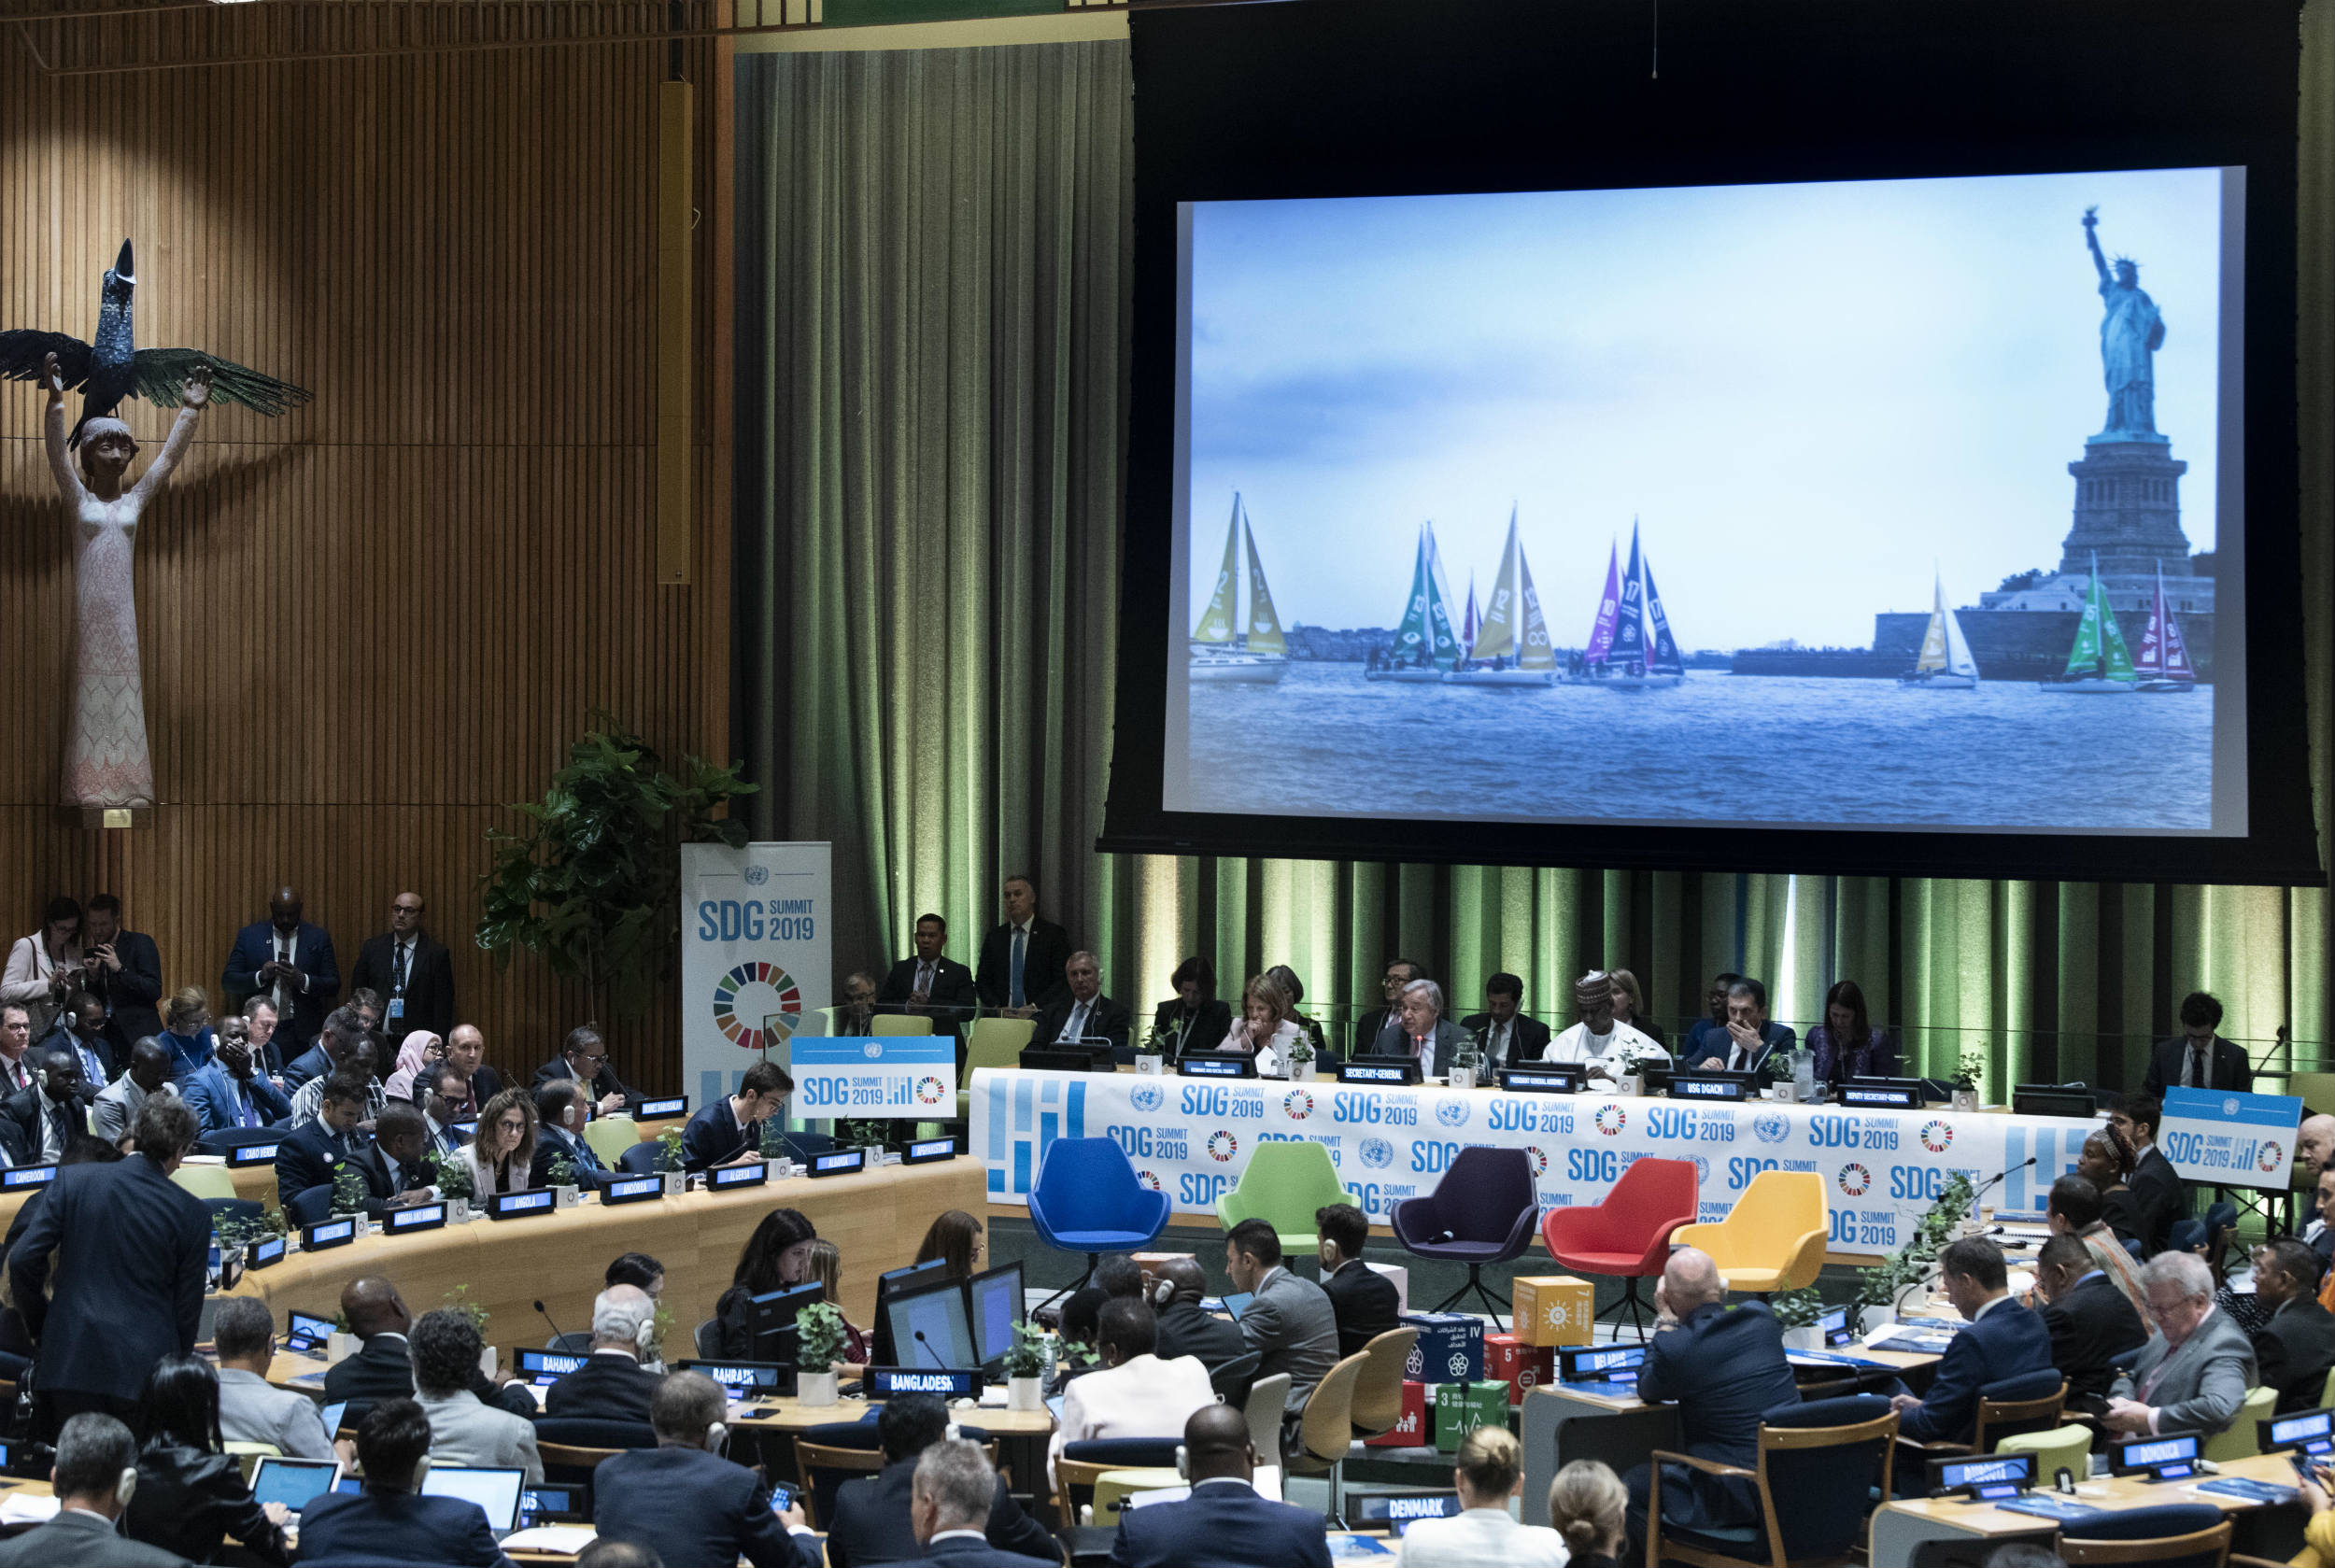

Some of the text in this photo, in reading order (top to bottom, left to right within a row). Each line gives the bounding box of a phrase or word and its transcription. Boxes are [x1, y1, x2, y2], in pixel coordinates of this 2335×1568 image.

[1626, 580, 1640, 602] 17
[770, 899, 814, 914] SUMMIT
[699, 899, 764, 941] SDG
[770, 917, 814, 940] 2019
[853, 1077, 883, 1087] SUMMIT
[1345, 1067, 1403, 1081] SECRETARY-GENERAL
[803, 1076, 849, 1106] SDG
[853, 1088, 884, 1106] 2019
[1181, 1084, 1229, 1116] SDG
[1233, 1085, 1266, 1097] SUMMIT
[1385, 1093, 1418, 1106] SUMMIT
[1231, 1099, 1264, 1119] 2019
[1334, 1092, 1381, 1123] SDG
[1384, 1107, 1418, 1126] 2019
[1488, 1099, 1537, 1132] SDG
[1542, 1101, 1576, 1114] SUMMIT
[1702, 1108, 1736, 1121] SUMMIT
[1541, 1114, 1575, 1134] 2019
[1647, 1107, 1697, 1140] SDG
[1700, 1123, 1735, 1142] 2019
[1809, 1114, 1860, 1148] SDG
[1864, 1117, 1900, 1130] SUMMIT
[1156, 1127, 1188, 1139] SUMMIT
[1863, 1130, 1899, 1151] 2019
[2207, 1135, 2233, 1148] SUMMIT
[916, 1141, 948, 1156] AFGHANISTAN
[1156, 1141, 1188, 1160] 2019
[1411, 1140, 1459, 1173] SDG
[2164, 1131, 2204, 1165] SDG
[1568, 1149, 1617, 1183] SDG
[1783, 1159, 1817, 1172] SUMMIT
[2202, 1149, 2230, 1168] 2019
[15, 1169, 46, 1184] CAMEROON
[729, 1167, 750, 1182] ALGERIA
[1890, 1165, 1942, 1201] SDG
[623, 1180, 647, 1195] ANDORRA
[1383, 1183, 1417, 1196] SUMMIT
[515, 1196, 536, 1209] ANGOLA
[1343, 1181, 1380, 1215] DG
[1539, 1193, 1573, 1206] SUMMIT
[1699, 1201, 1734, 1214] SUMMIT
[1861, 1210, 1895, 1224] SUMMIT
[1861, 1225, 1896, 1246] 2019
[1505, 1348, 1512, 1363] 5
[713, 1367, 754, 1385] BAHRAIN
[890, 1374, 955, 1391] BANGLADESH
[1440, 1391, 1449, 1406] 3
[1389, 1497, 1444, 1519] DENMARK
